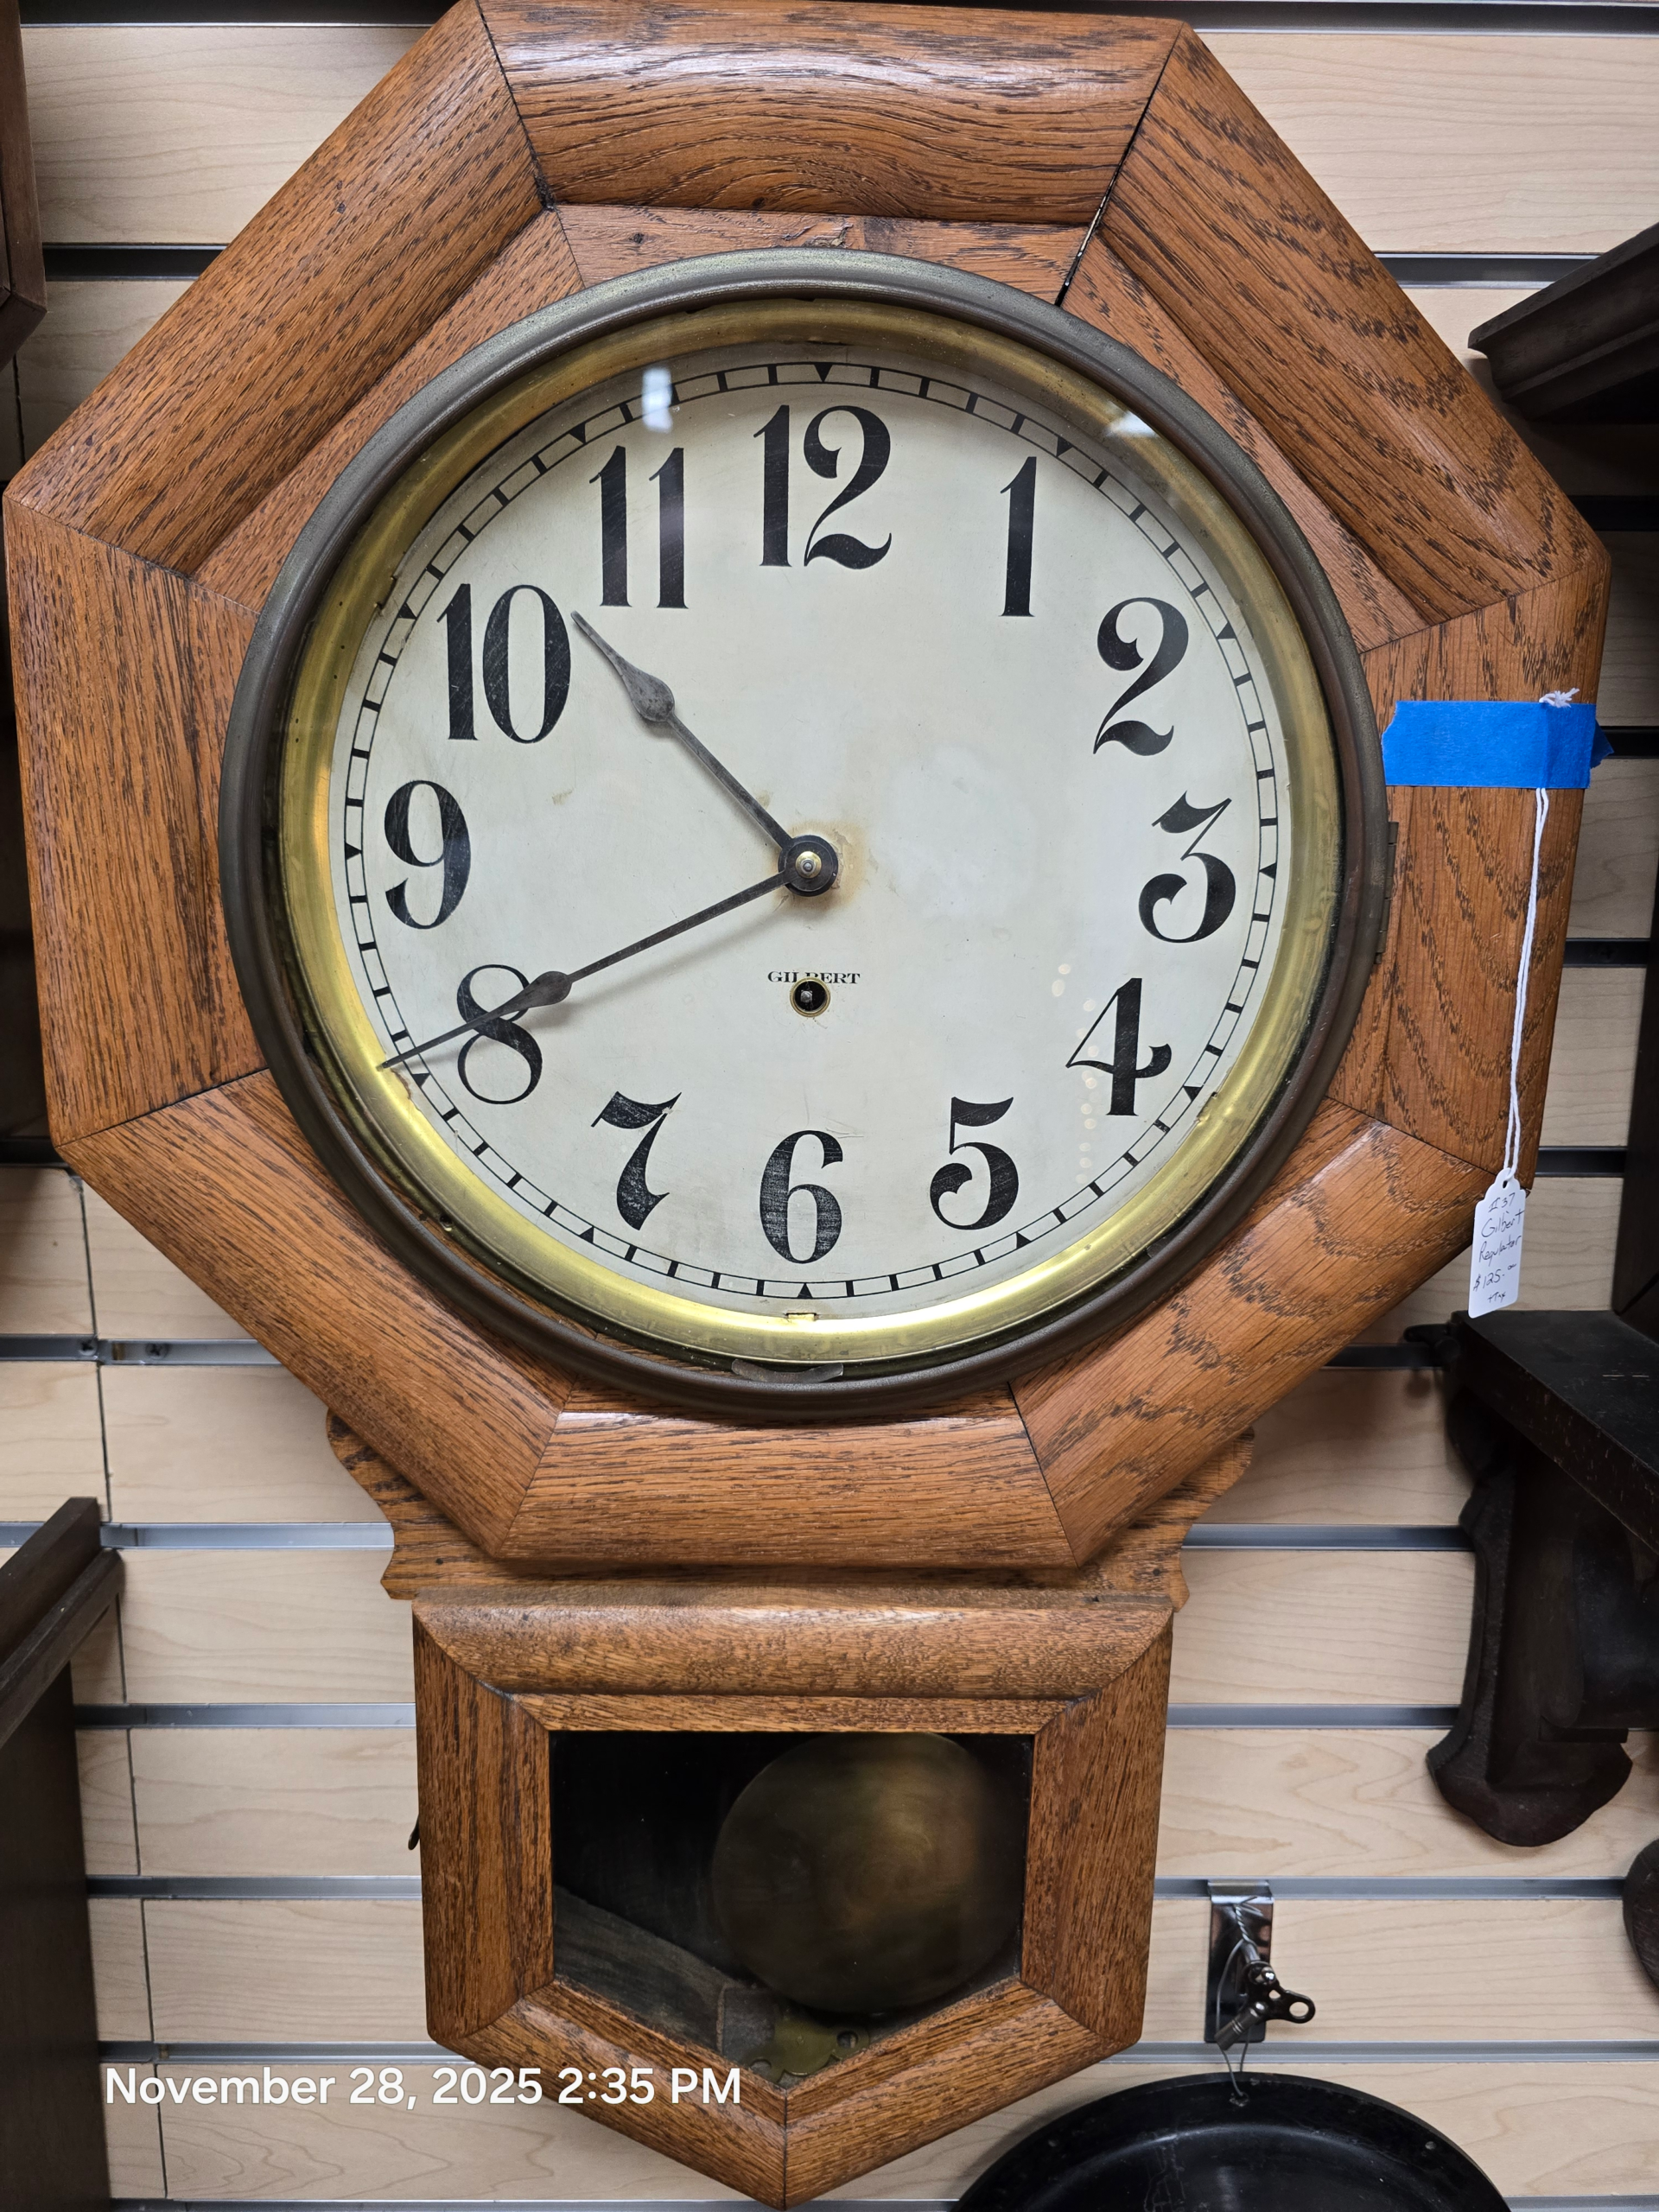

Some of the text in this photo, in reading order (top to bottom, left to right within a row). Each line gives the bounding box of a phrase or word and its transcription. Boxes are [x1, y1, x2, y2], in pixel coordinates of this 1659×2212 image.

[589, 444, 688, 609] 11
[753, 404, 893, 569] 12
[1000, 455, 1038, 617] 1
[436, 582, 571, 744] 10
[1093, 597, 1189, 756] 2
[384, 779, 471, 930] 9
[1138, 792, 1236, 944] 3
[456, 963, 543, 1105] 8
[1065, 977, 1173, 1116] 4
[590, 1090, 682, 1231] 7
[759, 1129, 843, 1264] 6
[929, 1096, 1020, 1230] 5
[1481, 1209, 1525, 1238] Gilbert
